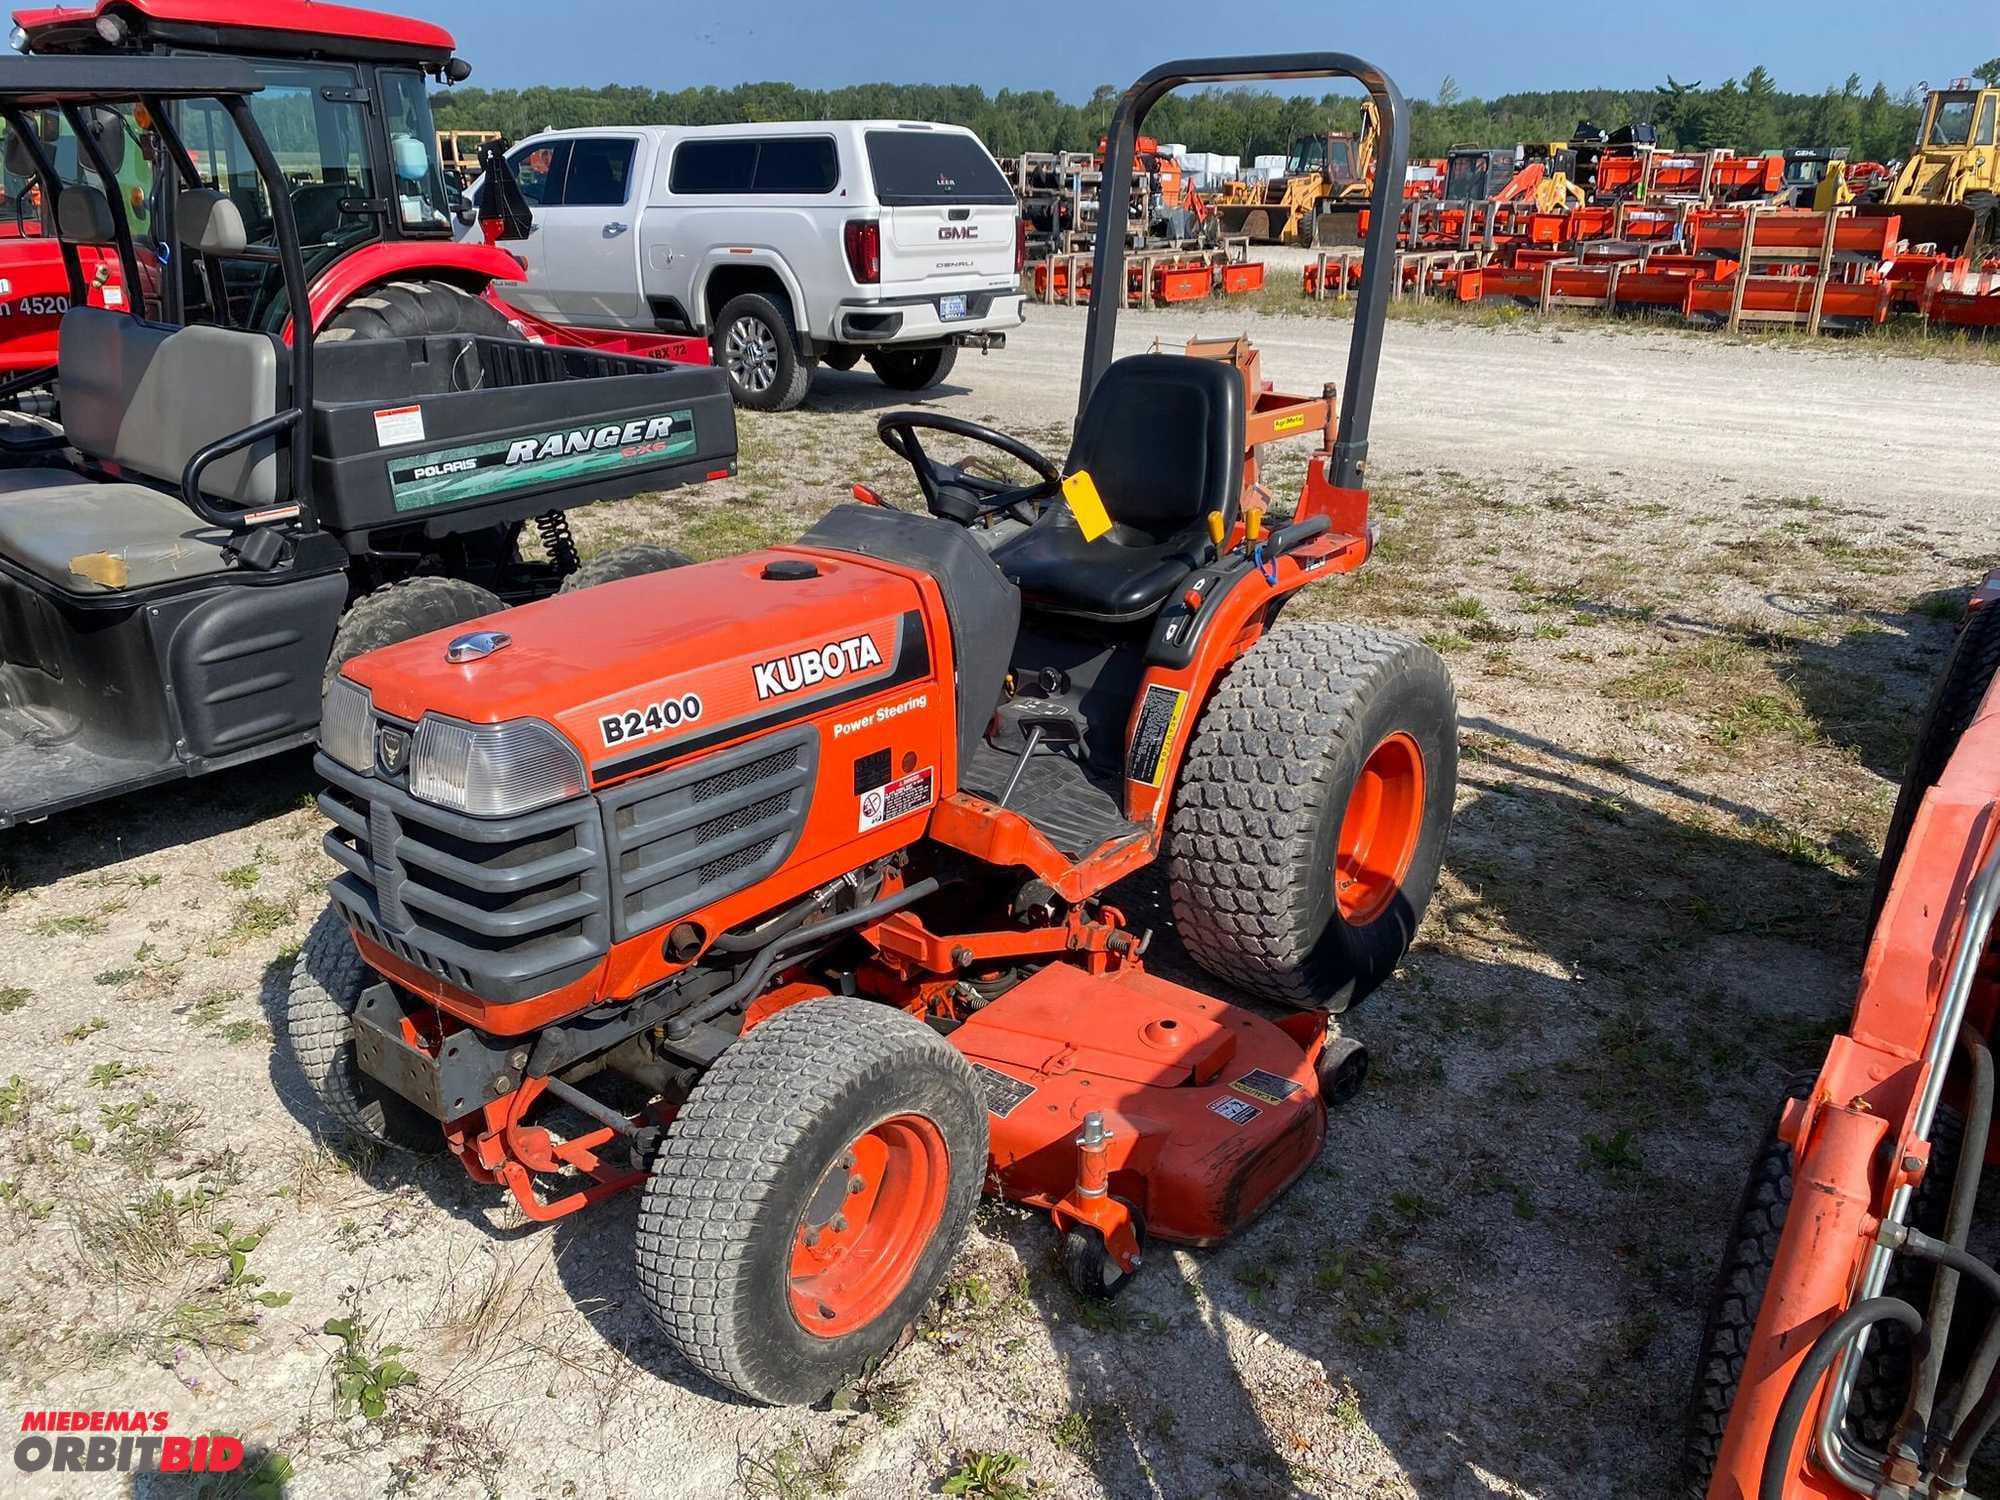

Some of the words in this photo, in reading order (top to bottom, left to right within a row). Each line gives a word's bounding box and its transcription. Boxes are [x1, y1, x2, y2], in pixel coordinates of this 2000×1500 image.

[938, 226, 979, 241] GMC
[20, 296, 68, 315] 4520
[673, 343, 687, 356] 72
[414, 458, 477, 480] POLARIS
[505, 416, 674, 465] RANGER
[753, 634, 883, 700] KUBOTA
[600, 693, 703, 748] B2400
[833, 714, 875, 740] Power
[875, 694, 928, 722] Steering
